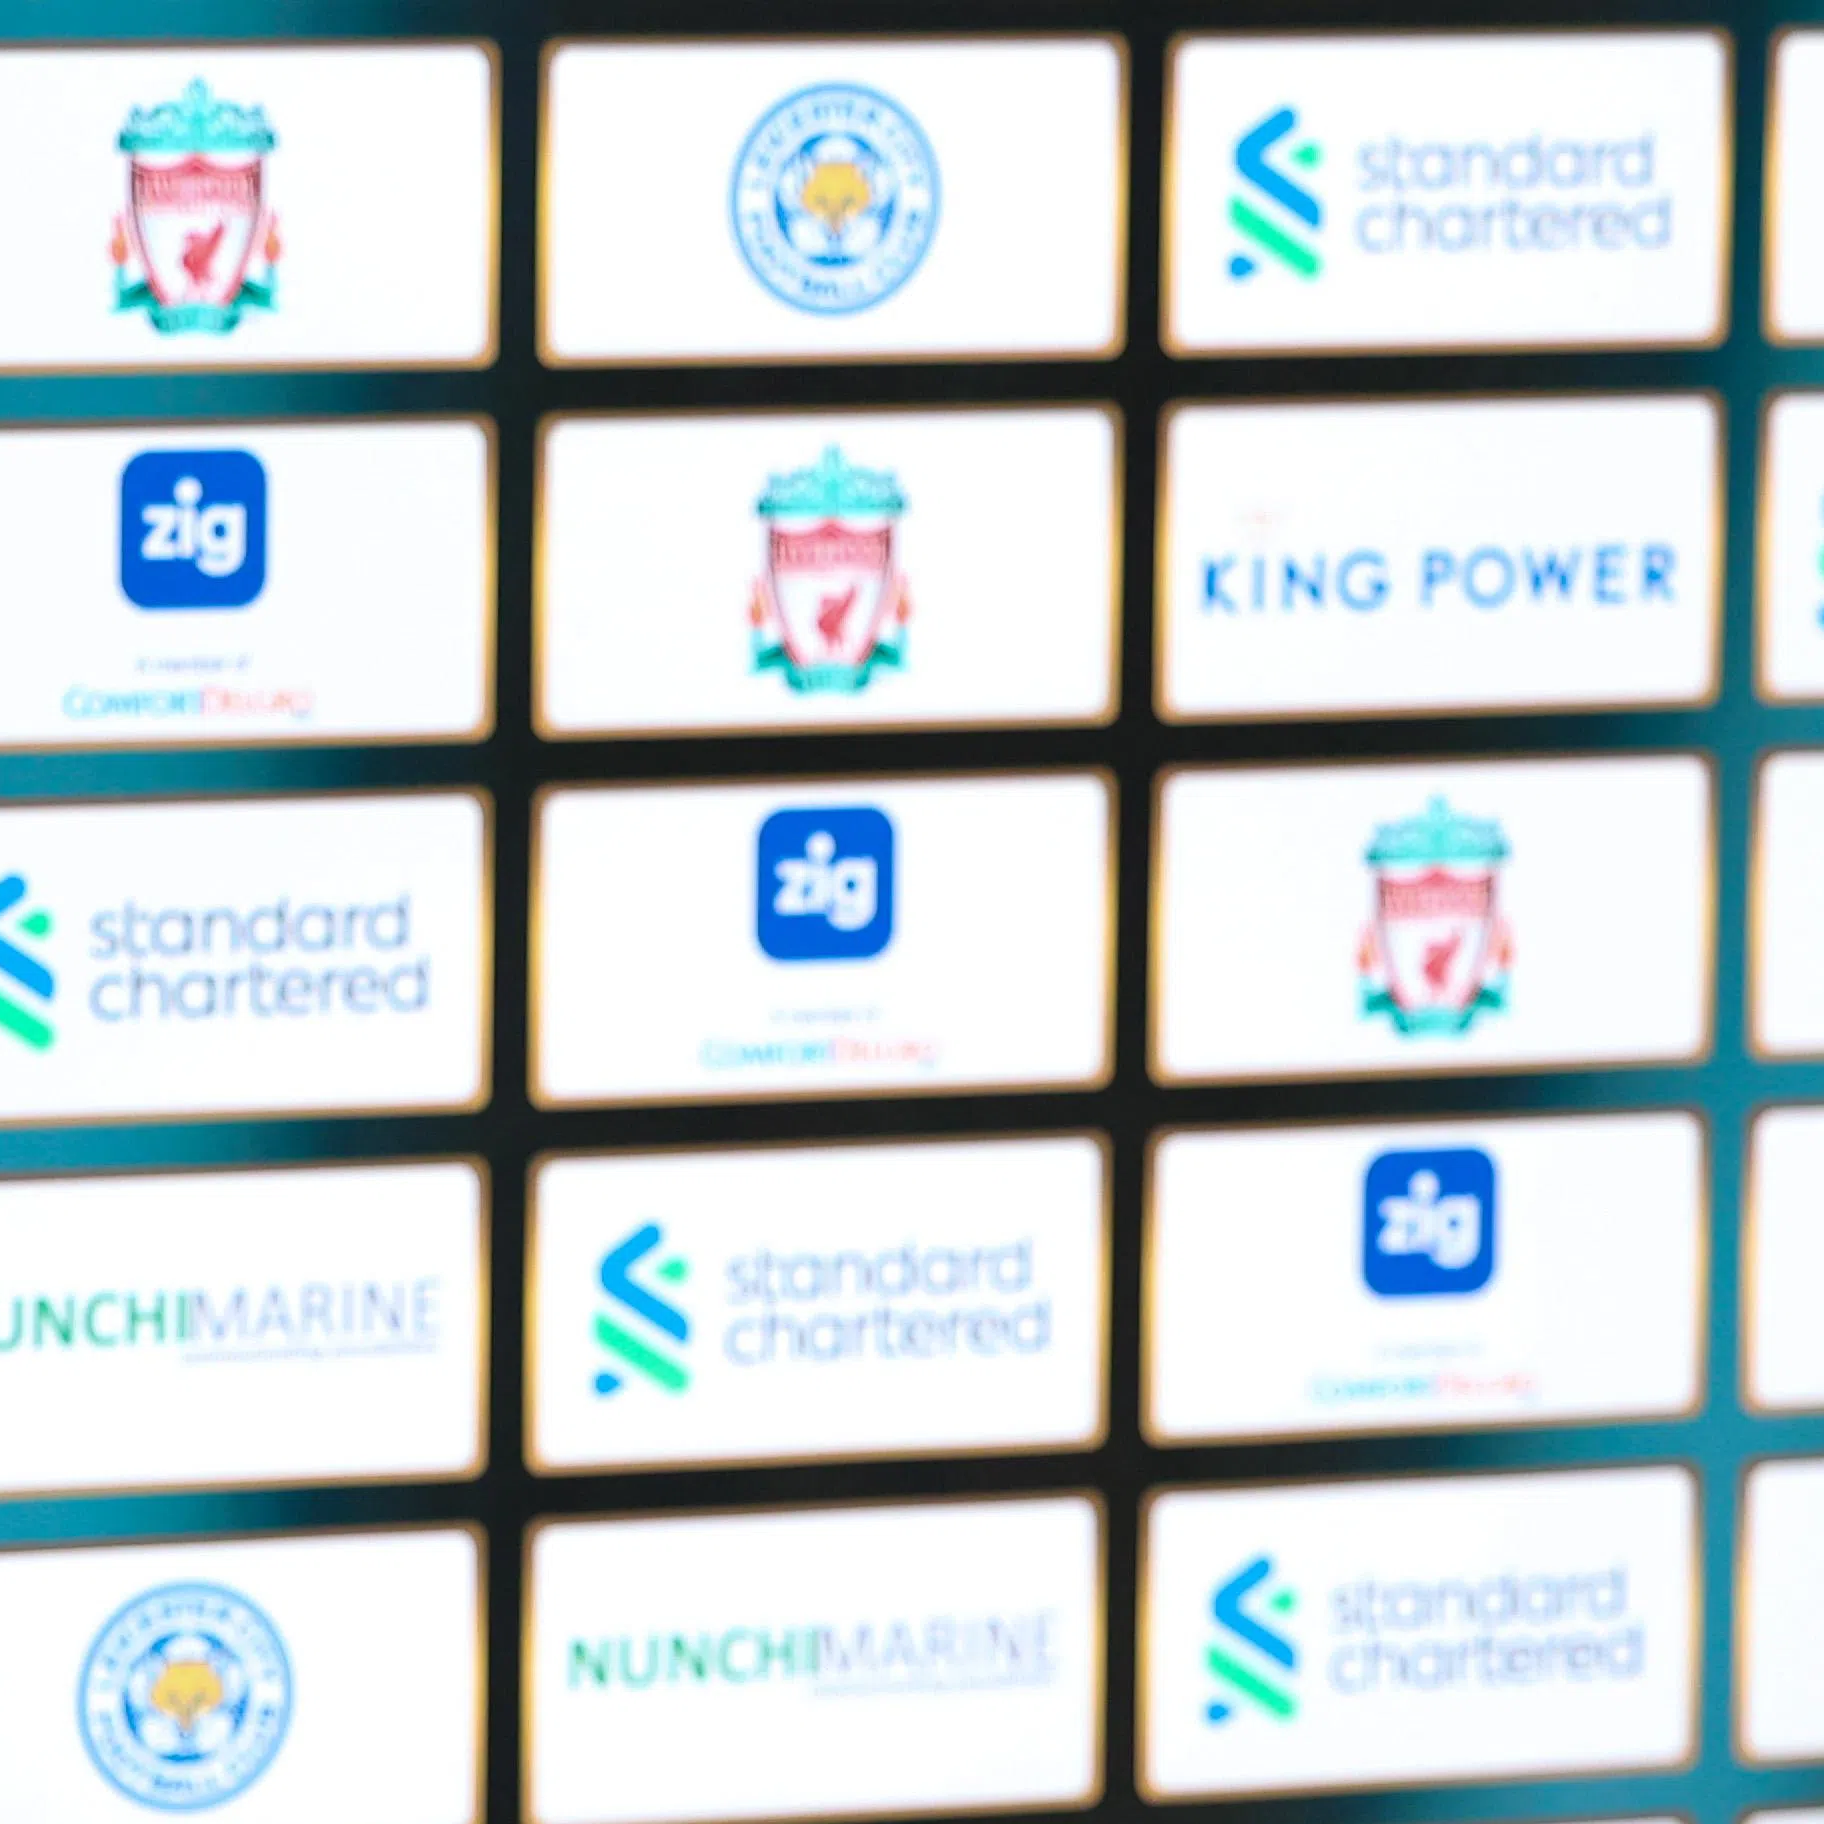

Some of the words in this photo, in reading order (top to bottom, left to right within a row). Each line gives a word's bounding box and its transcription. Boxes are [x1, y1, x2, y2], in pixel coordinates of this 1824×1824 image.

[1354, 130, 1658, 193] standard
[1354, 190, 1676, 255] chartered
[140, 479, 248, 580] zig
[1198, 546, 1392, 617] KING
[1417, 540, 1679, 607] POWER
[775, 832, 882, 930] zig
[88, 890, 414, 956] standard
[88, 952, 431, 1024] chartered
[724, 1232, 1033, 1300] standard
[723, 1292, 1054, 1368] chartered
